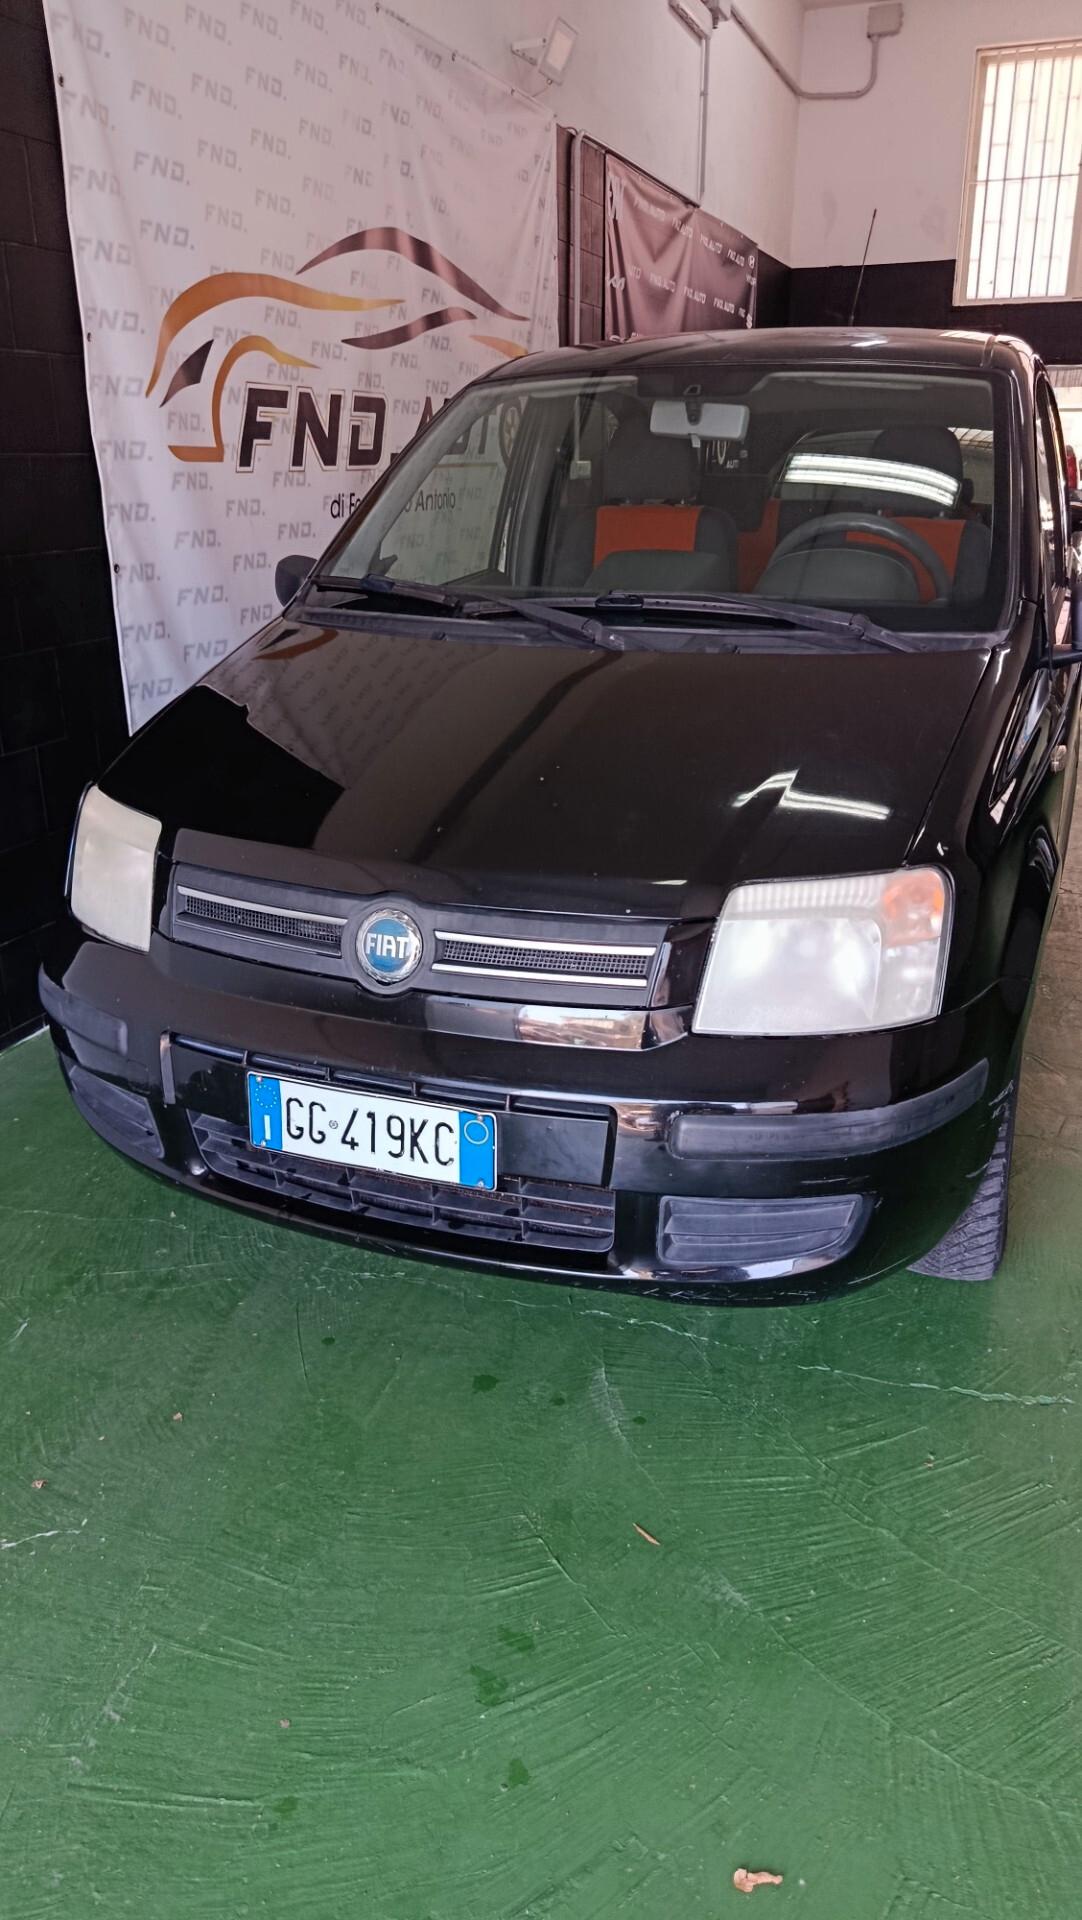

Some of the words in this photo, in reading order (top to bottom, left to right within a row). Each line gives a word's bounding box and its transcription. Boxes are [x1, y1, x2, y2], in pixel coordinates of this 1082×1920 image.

[123, 8, 176, 51] FND.
[184, 4, 232, 46] FND.
[240, 2, 283, 40] FND.
[289, 0, 328, 35] FND.
[245, 65, 287, 101] FND.
[293, 59, 333, 93] FND.
[338, 52, 373, 85] FND.
[130, 79, 182, 120] FND.
[191, 72, 237, 110] FND.
[251, 128, 291, 160] FND.
[298, 118, 335, 149] FND.
[133, 151, 190, 186] FND.
[197, 138, 242, 173] FND.
[204, 203, 248, 234] FND.
[255, 188, 296, 218] FND.
[139, 218, 195, 250] FND.
[264, 305, 302, 328] FND.
[310, 339, 347, 361] FND.
[167, 410, 206, 432] FND.
[171, 471, 213, 491] FND.
[272, 471, 311, 488] FND.
[225, 498, 266, 518] FND.
[331, 493, 345, 518] di
[415, 489, 456, 512] Antonio
[174, 529, 221, 548] FND.
[277, 521, 316, 541] FND.
[232, 552, 272, 574] FND.
[177, 584, 229, 606] FND.
[365, 933, 411, 958] FIAT
